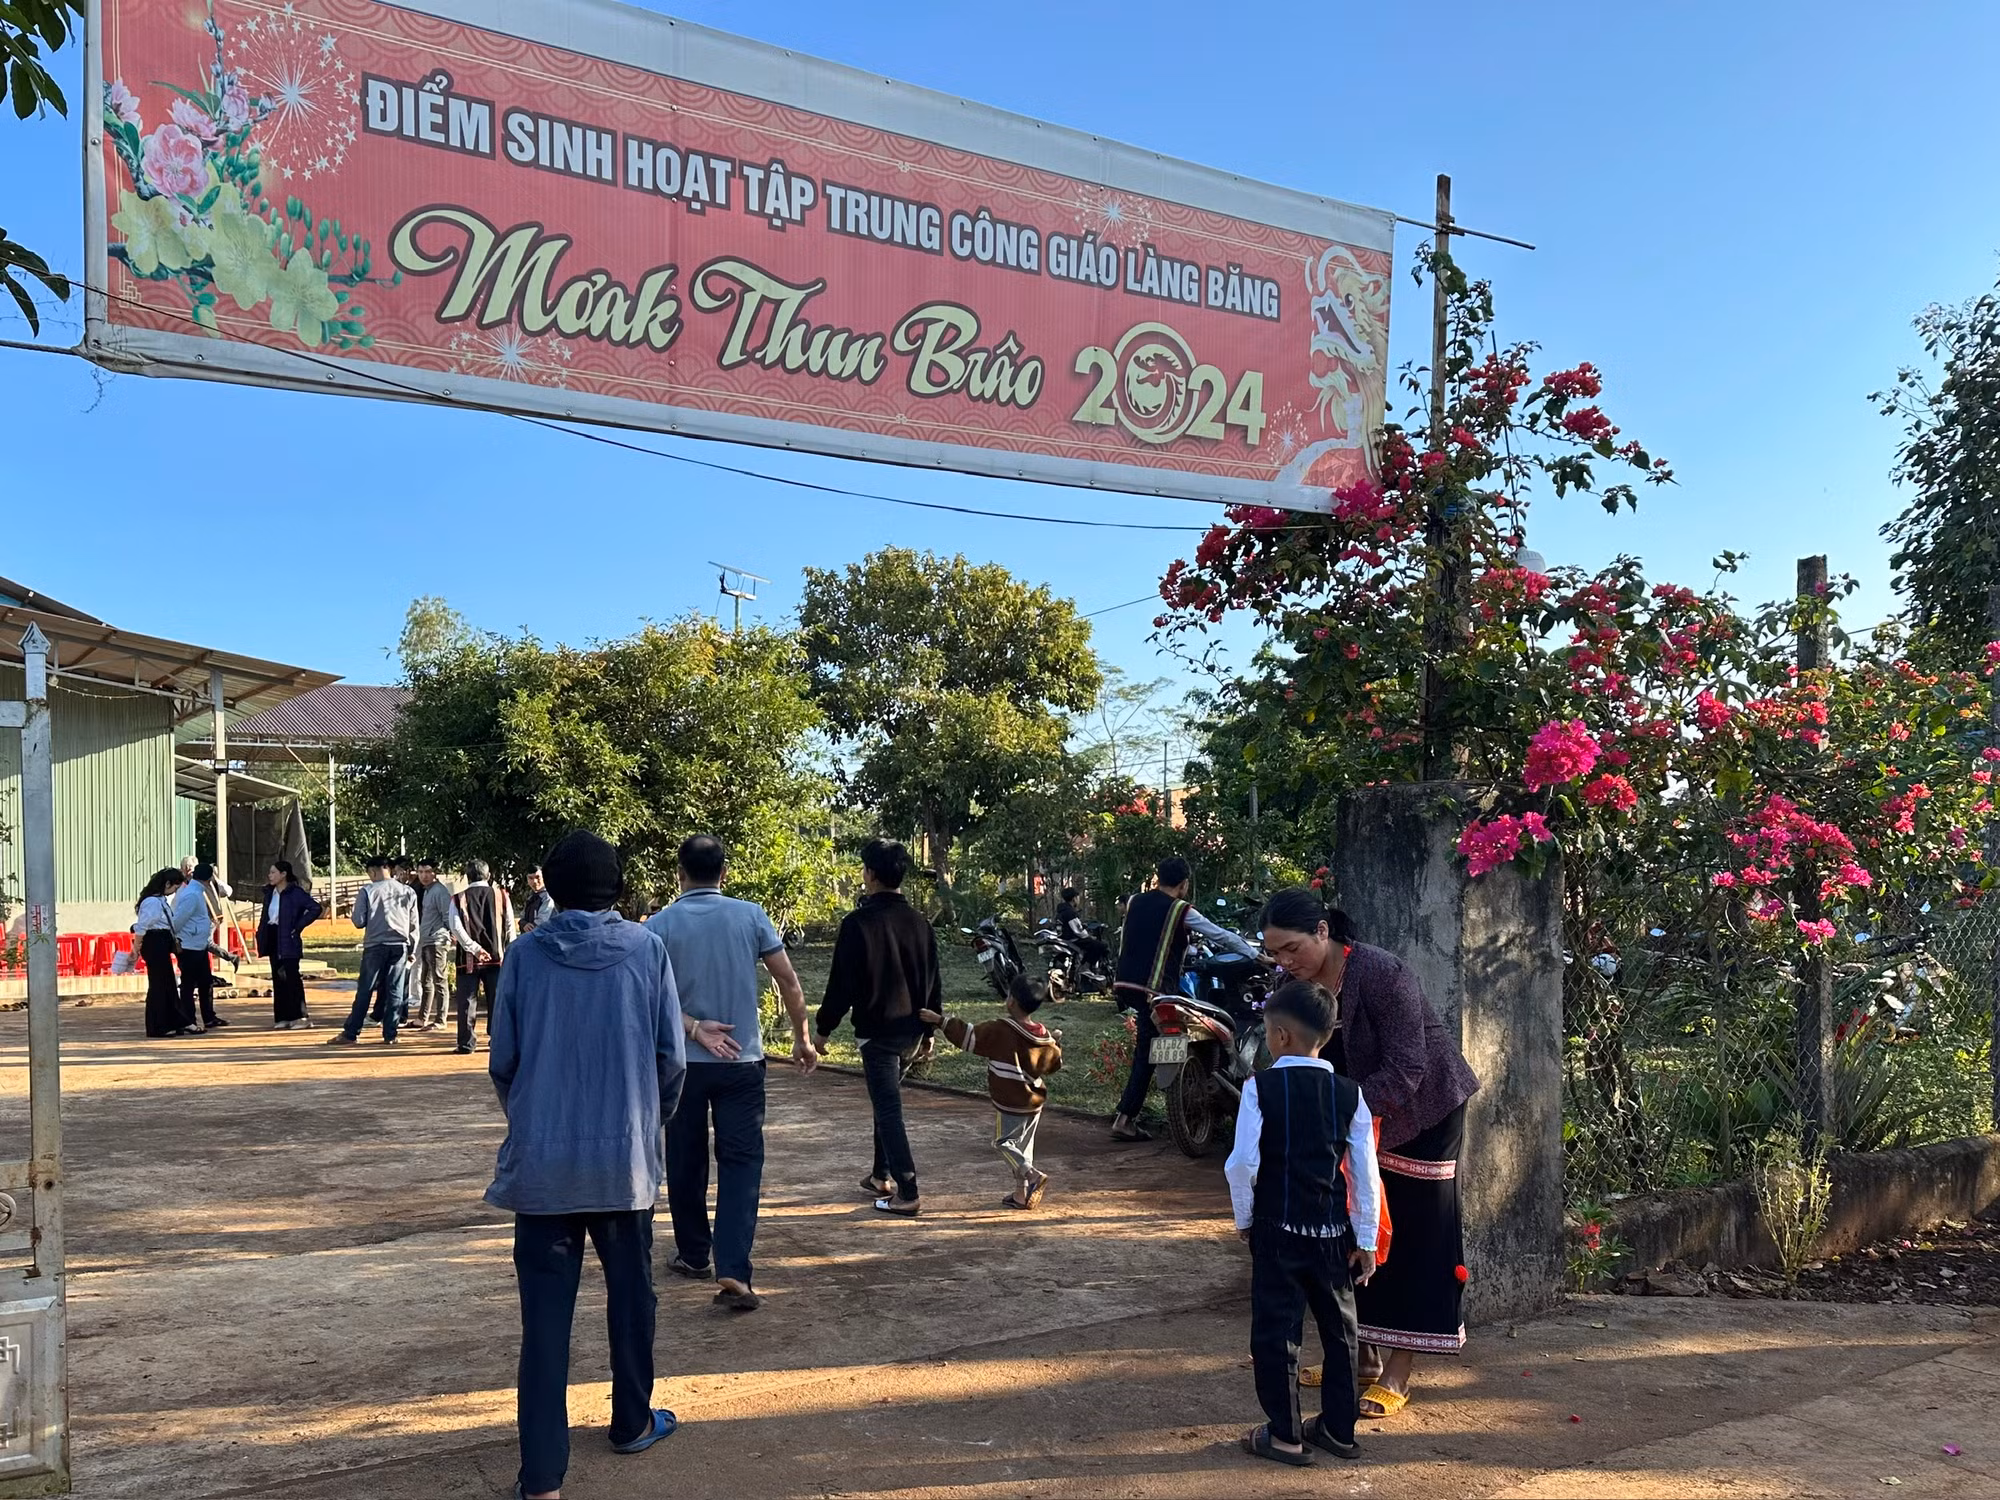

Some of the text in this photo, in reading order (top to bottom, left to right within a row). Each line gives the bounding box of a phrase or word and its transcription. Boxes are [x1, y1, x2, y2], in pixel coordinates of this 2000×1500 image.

[365, 73, 1280, 320] ĐIỂM SINH HOẠT TẬP TRUNG CÔNG GIÁO LÀNG BĂNG
[391, 208, 1043, 406] Mơak Thun Brâo
[1071, 320, 1267, 446] 2024
